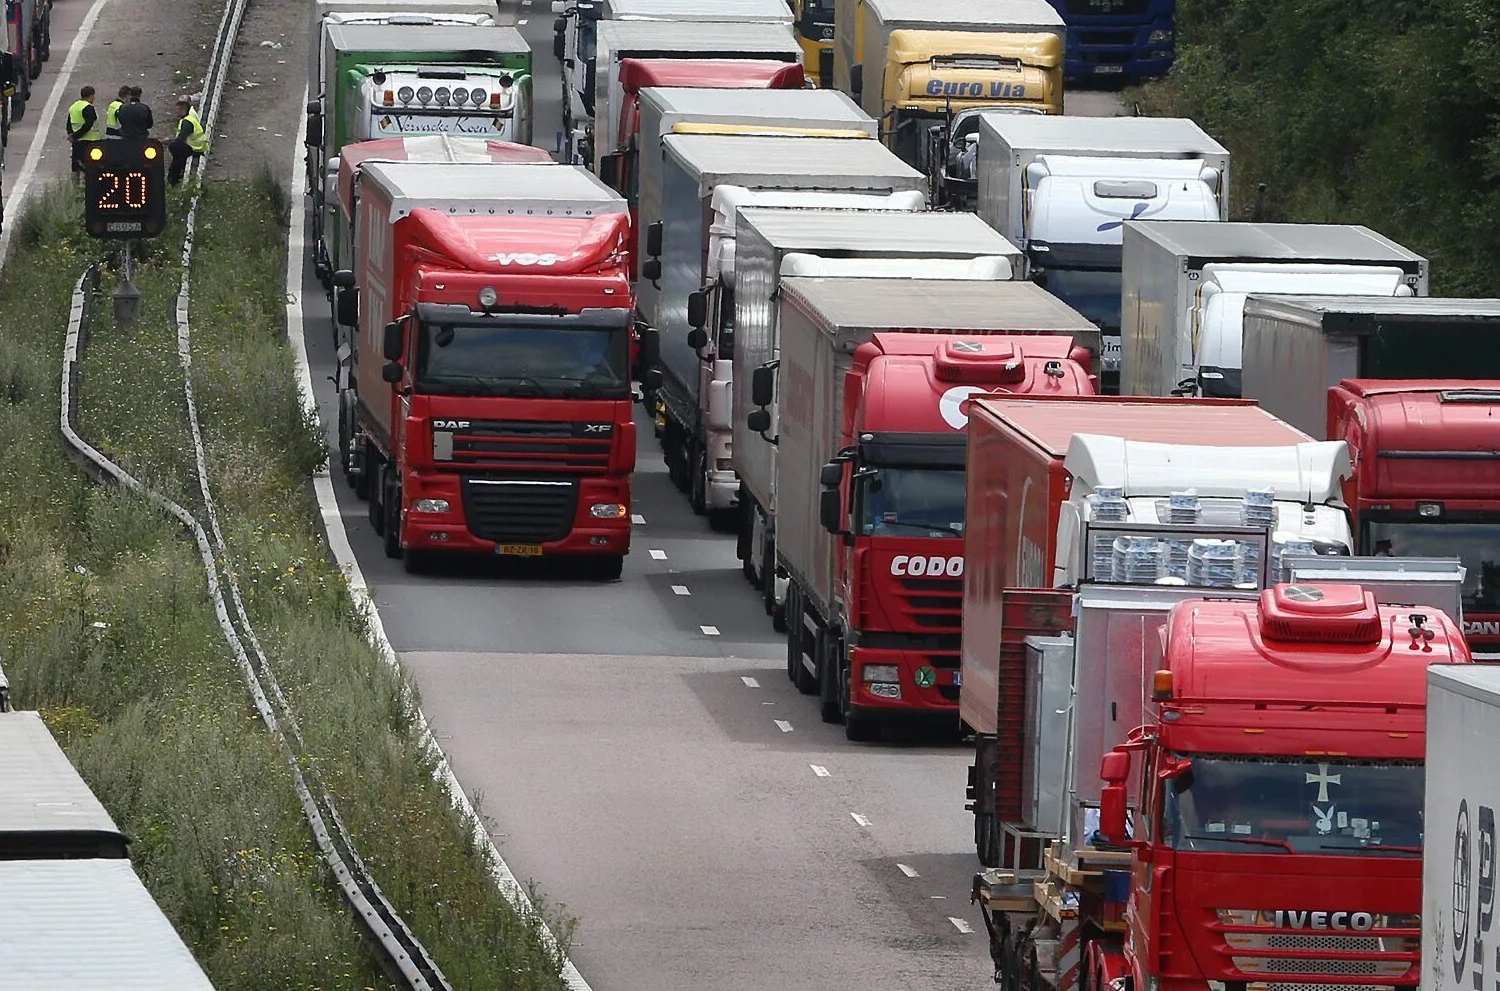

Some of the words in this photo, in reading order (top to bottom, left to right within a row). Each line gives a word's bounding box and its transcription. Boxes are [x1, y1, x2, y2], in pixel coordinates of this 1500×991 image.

[990, 81, 1026, 98] Via
[98, 172, 146, 209] 20
[496, 252, 557, 266] VOS
[433, 420, 470, 429] DAF
[583, 424, 612, 432] XF
[1275, 910, 1373, 931] IVECO
